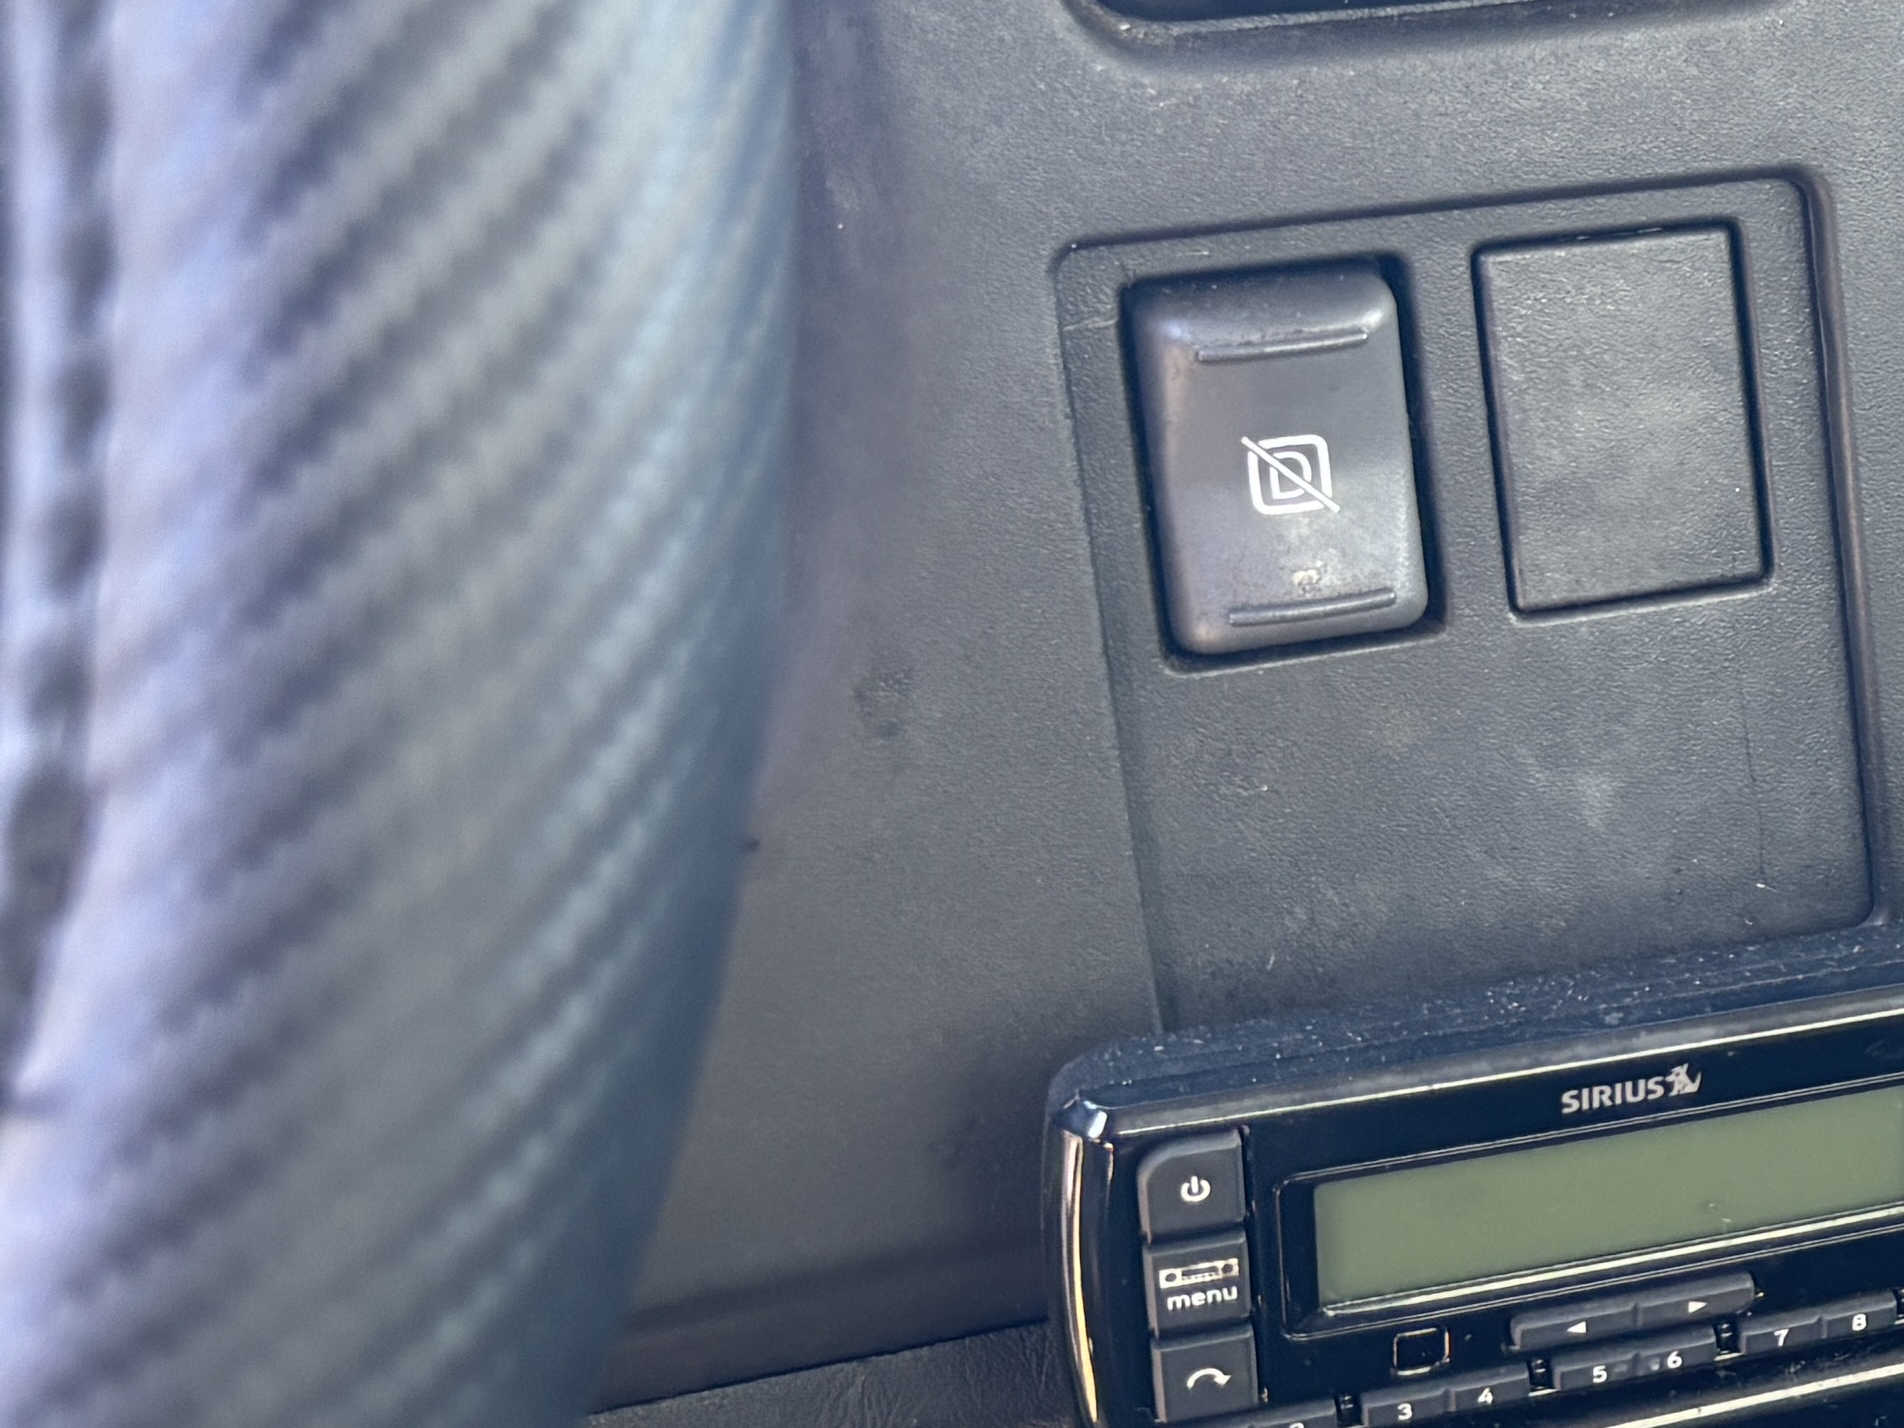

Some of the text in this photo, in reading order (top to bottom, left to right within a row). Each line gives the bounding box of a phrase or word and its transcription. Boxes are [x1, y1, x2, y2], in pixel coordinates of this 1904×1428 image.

[1561, 1075, 1665, 1114] SIRIUS
[1166, 1285, 1239, 1311] menu
[1396, 1403, 1414, 1422] 3
[1477, 1387, 1494, 1406] 4
[1591, 1366, 1608, 1384] 5
[1666, 1351, 1683, 1370] 6
[1773, 1329, 1790, 1349] 7
[1851, 1313, 1867, 1332] 8
